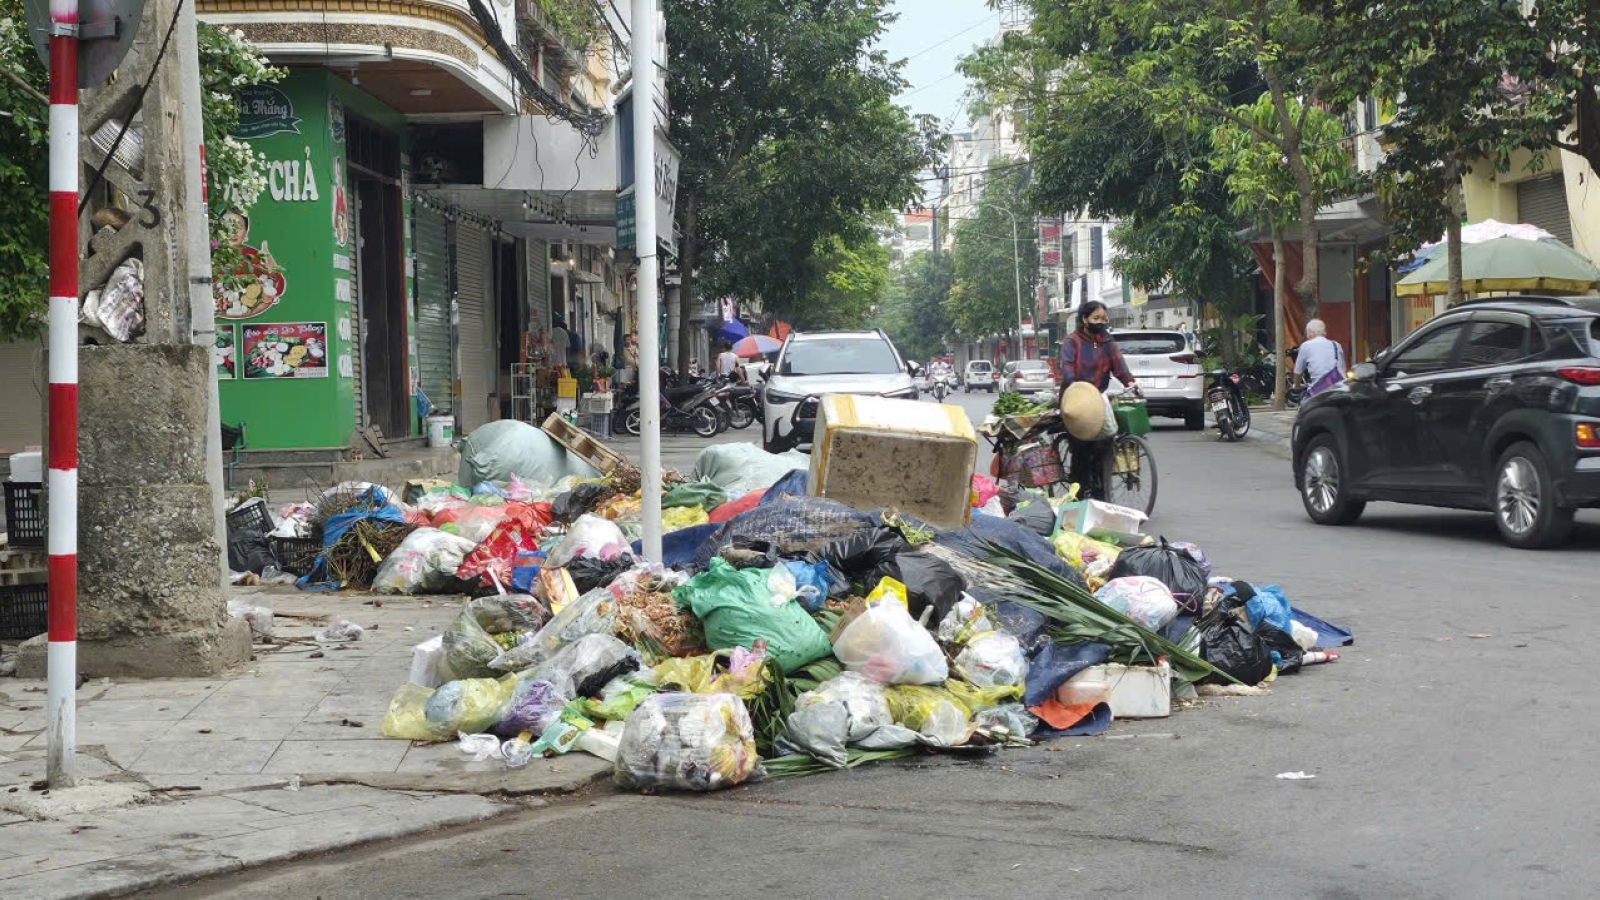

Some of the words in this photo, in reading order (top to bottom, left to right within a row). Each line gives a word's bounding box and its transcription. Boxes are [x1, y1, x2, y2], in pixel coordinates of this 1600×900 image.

[251, 96, 288, 120] Thắng
[268, 145, 319, 201] CHẢ
[137, 189, 161, 230] 3
